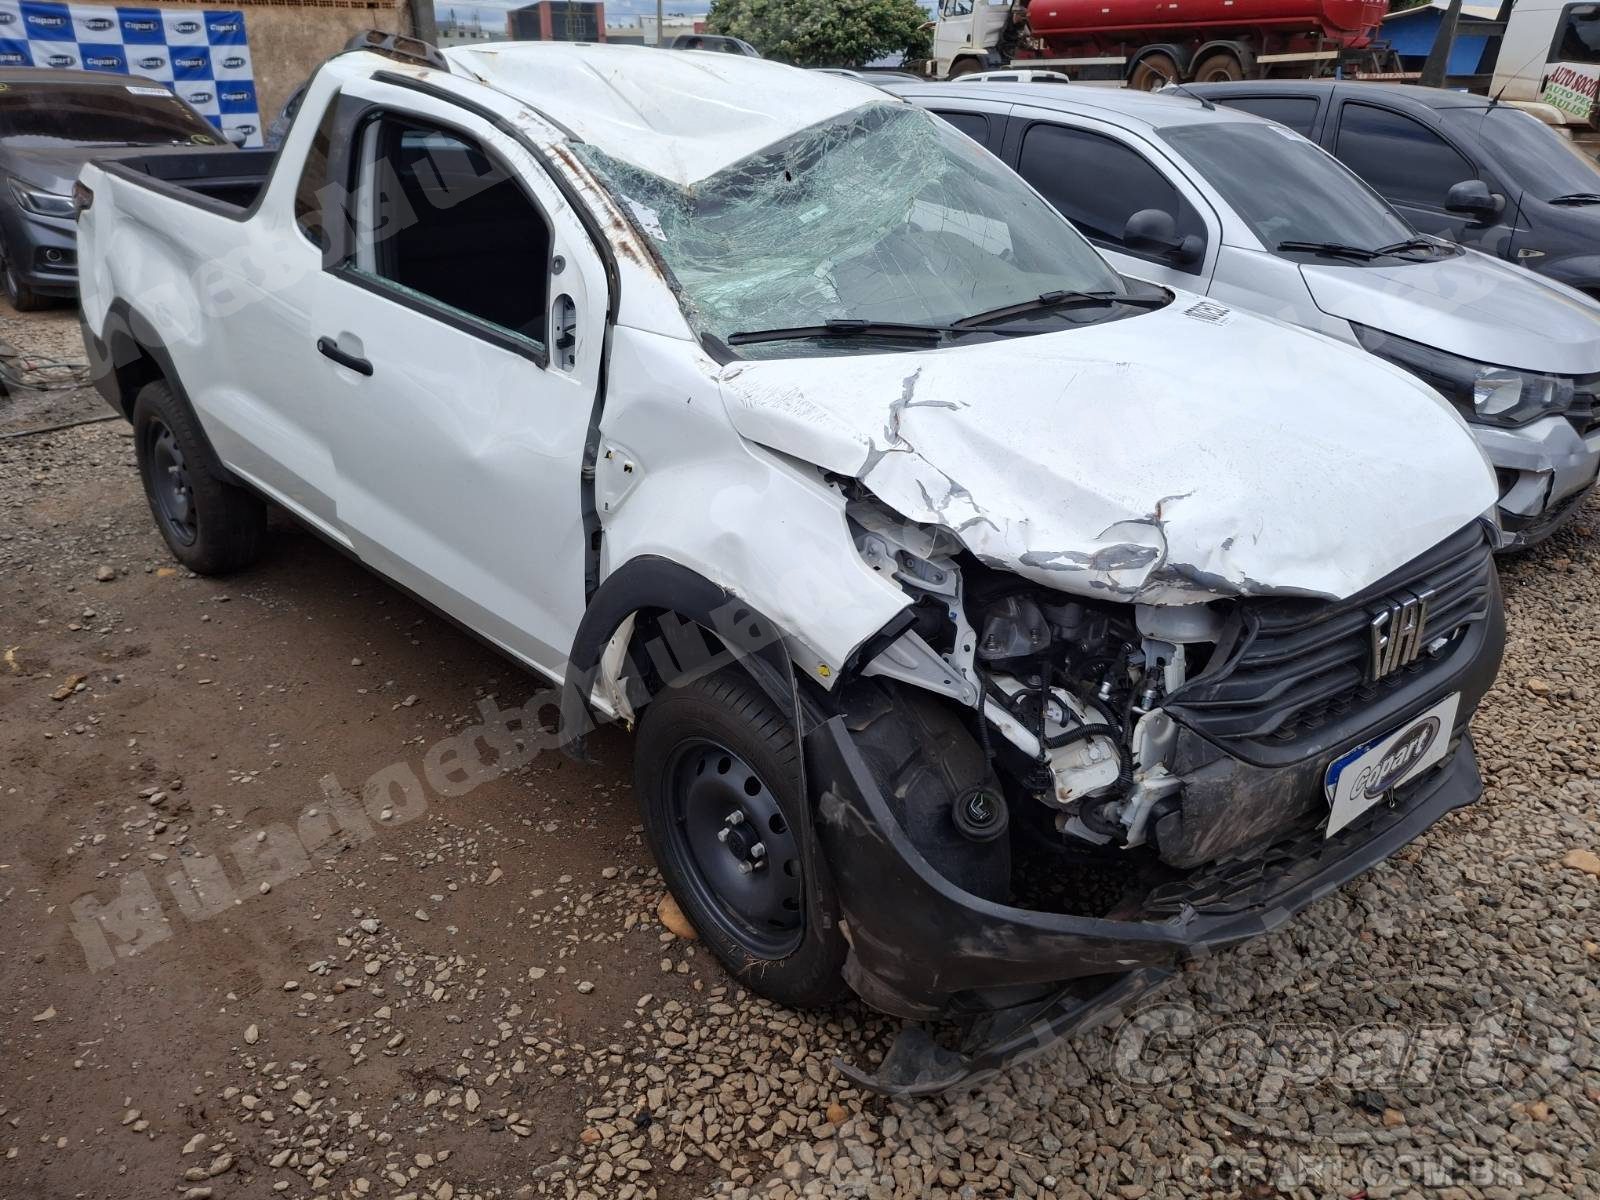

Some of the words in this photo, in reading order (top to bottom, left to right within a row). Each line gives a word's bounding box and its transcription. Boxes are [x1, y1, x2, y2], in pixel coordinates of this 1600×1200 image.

[1548, 66, 1577, 87] AUTO
[1545, 84, 1574, 99] AUTO
[1350, 723, 1431, 800] Copart
